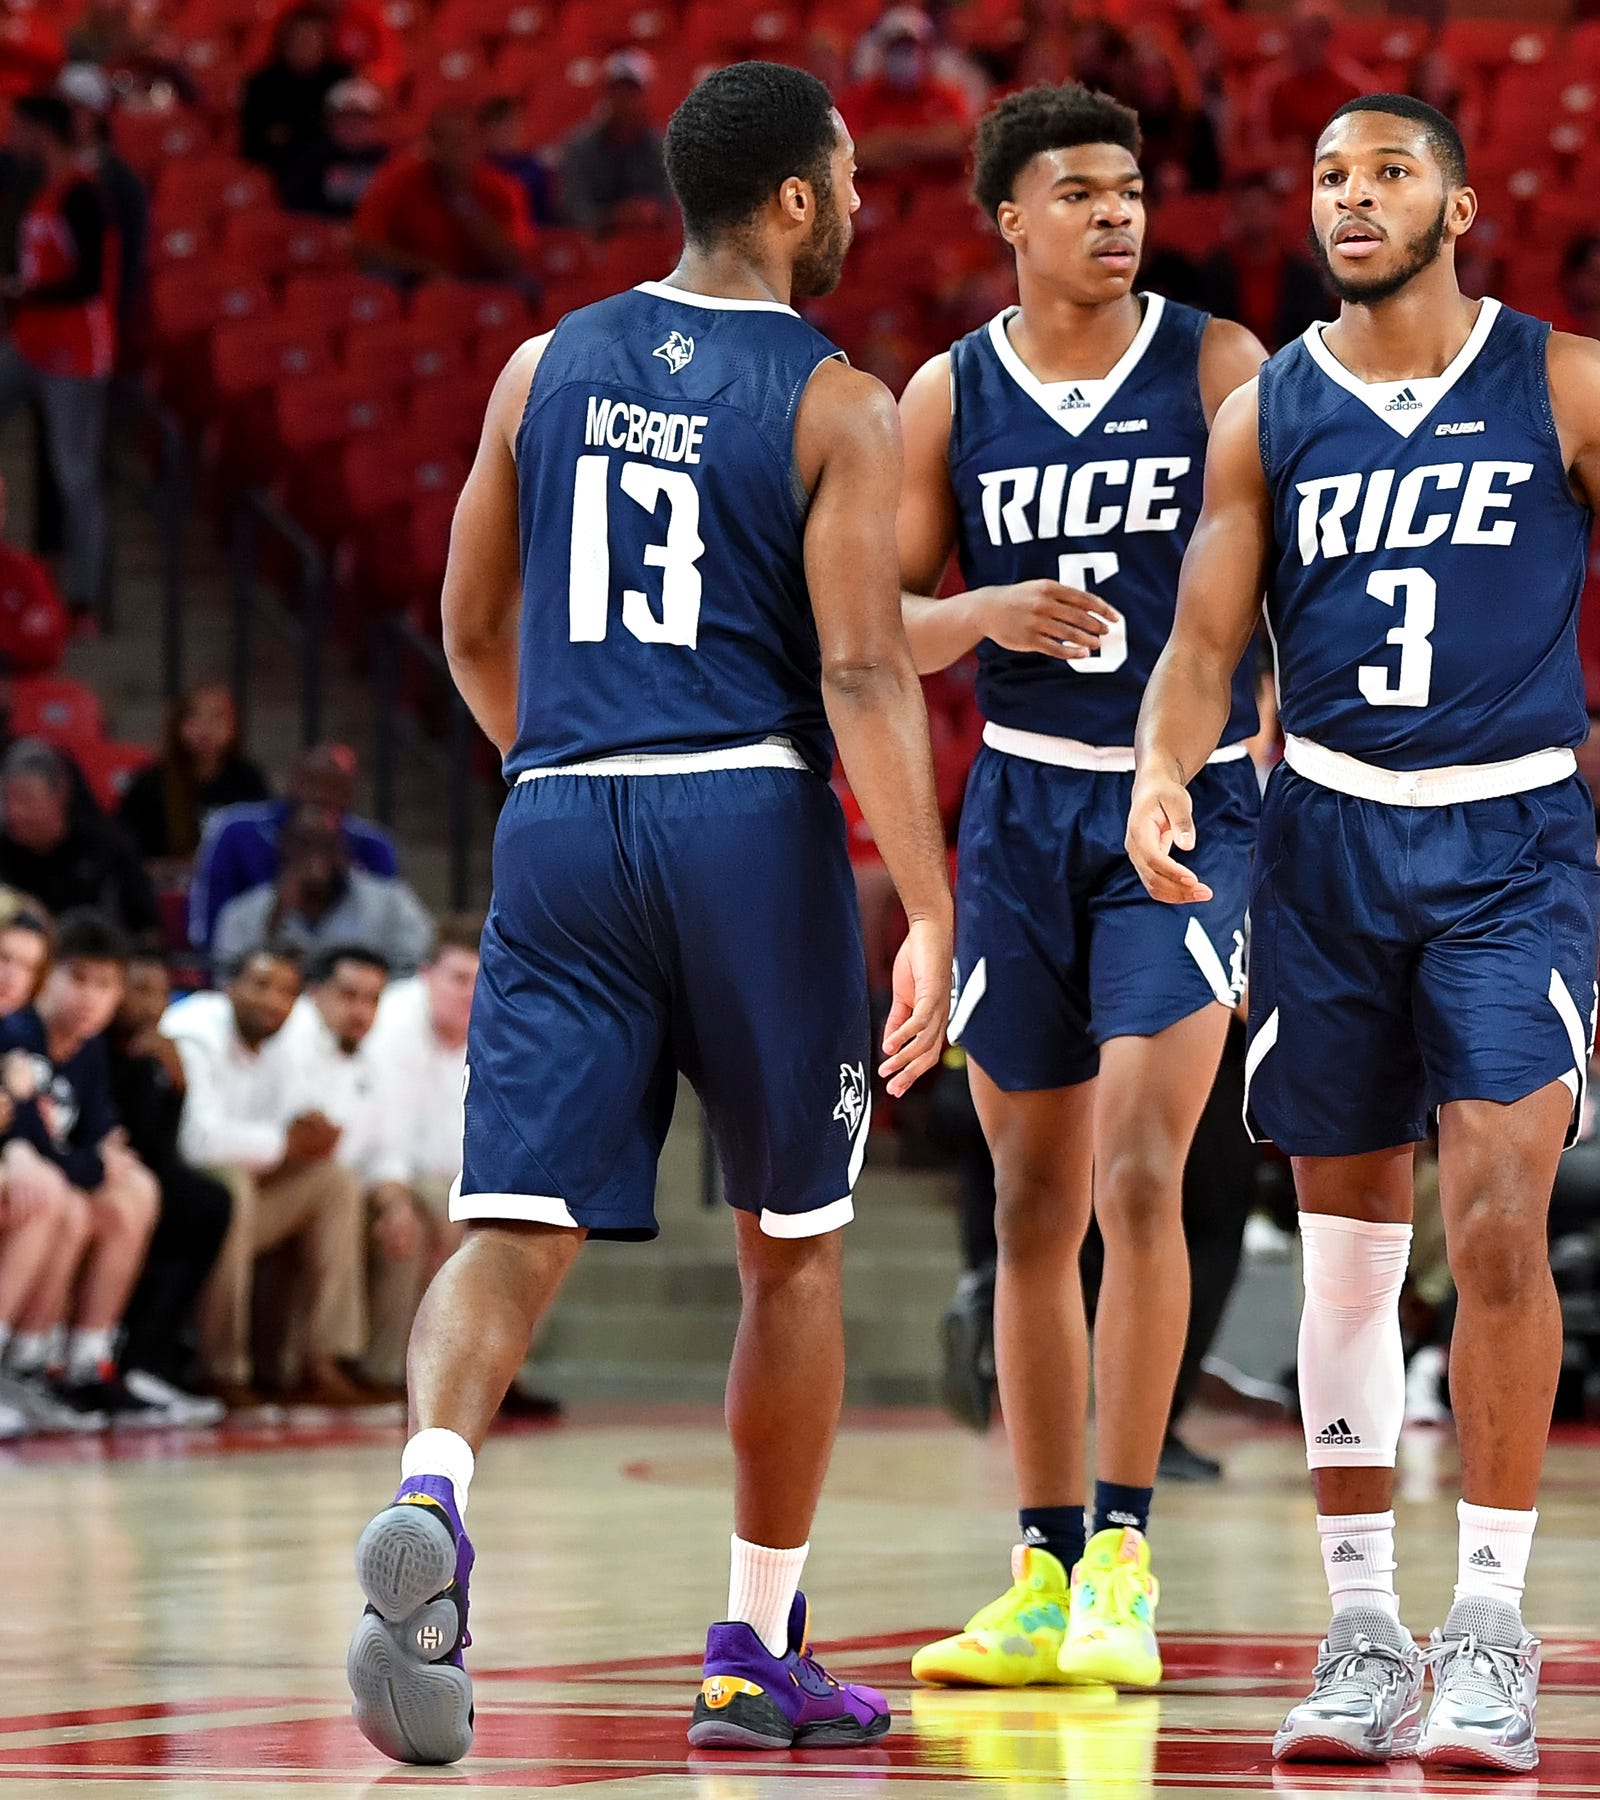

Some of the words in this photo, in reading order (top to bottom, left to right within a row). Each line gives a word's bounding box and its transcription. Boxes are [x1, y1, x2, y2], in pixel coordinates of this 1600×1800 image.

[584, 396, 709, 465] MCBRIDE
[1384, 400, 1424, 412] adidas
[978, 456, 1190, 546] RICE
[1295, 460, 1534, 567] RICE
[569, 454, 706, 650] 13
[1357, 567, 1438, 708] 3
[1315, 1433, 1361, 1445] adidas
